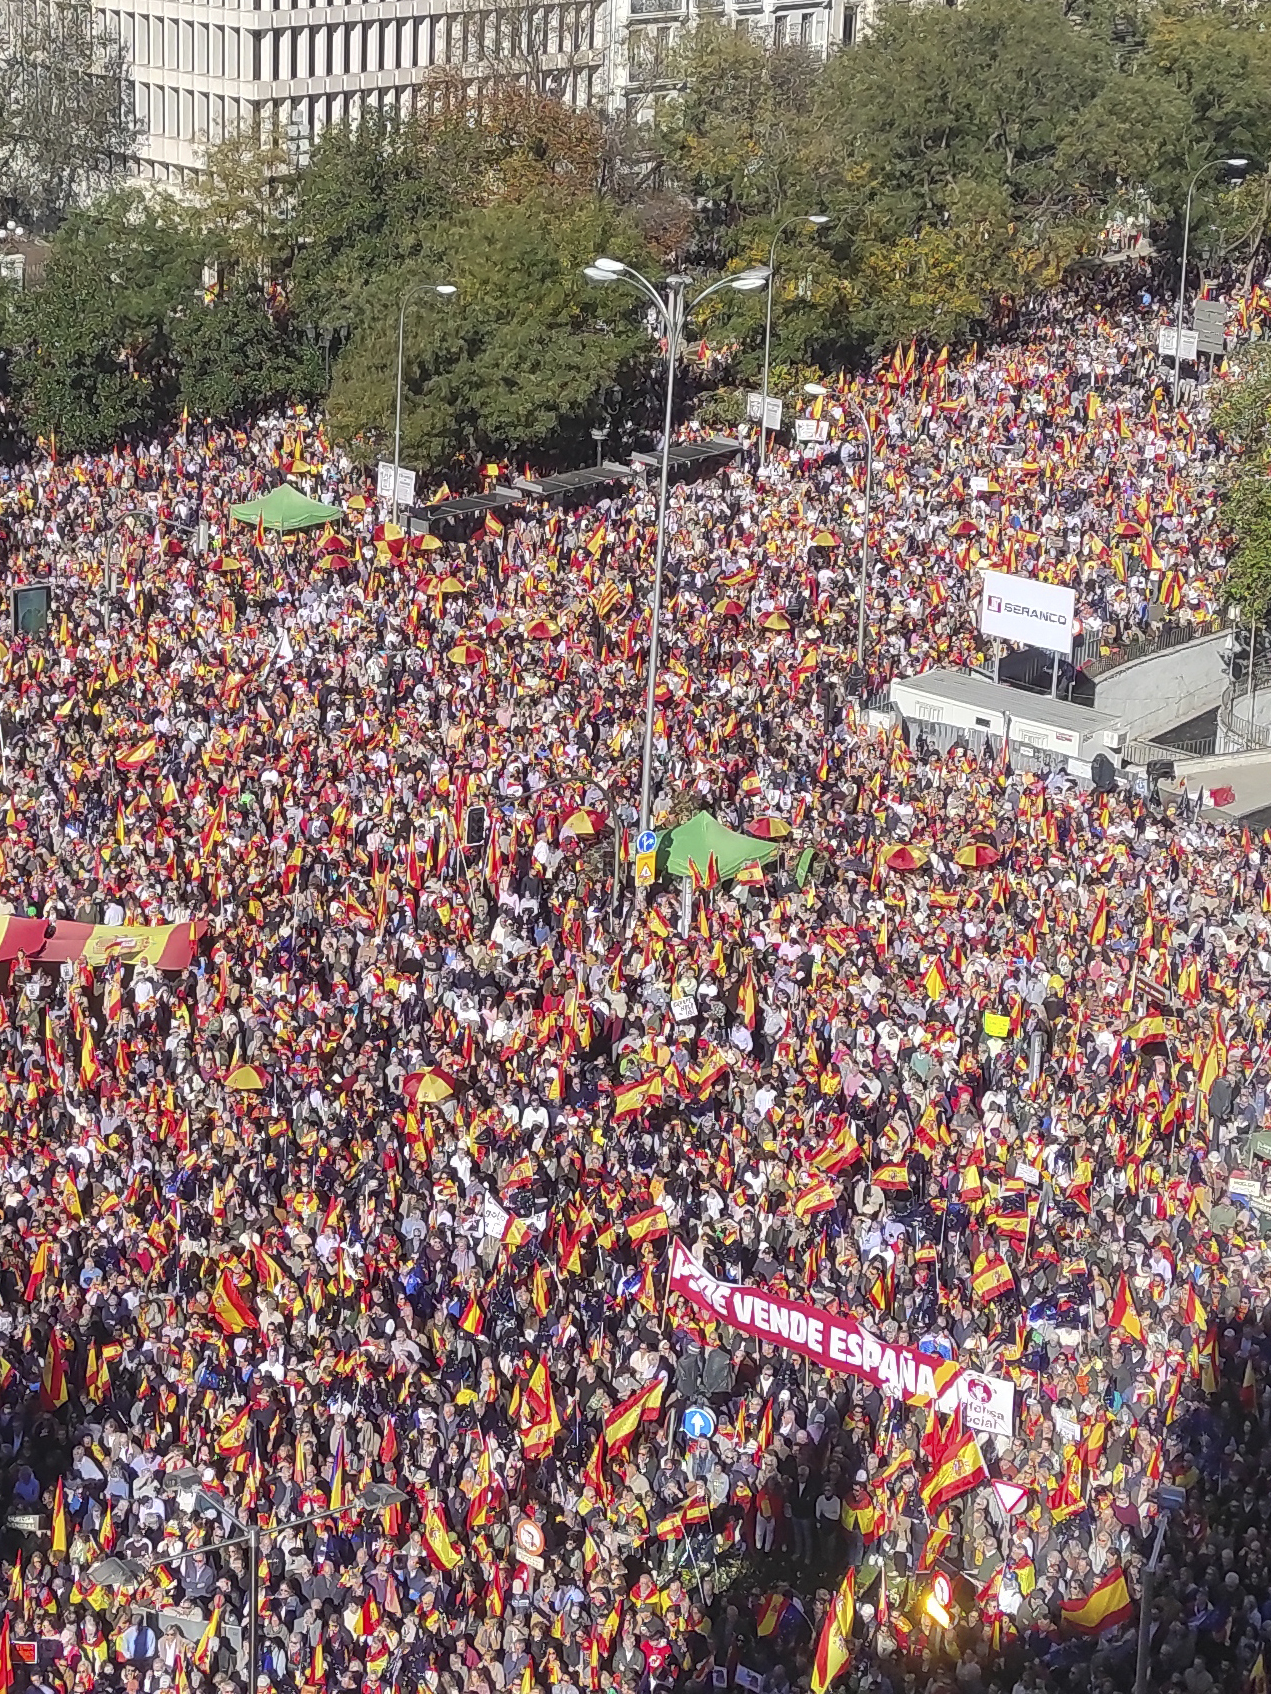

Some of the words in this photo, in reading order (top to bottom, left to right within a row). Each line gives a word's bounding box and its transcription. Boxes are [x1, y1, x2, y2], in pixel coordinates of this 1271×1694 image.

[1004, 602, 1067, 626] SERANCO
[733, 1291, 824, 1355] VENDE
[830, 1326, 938, 1399] ESPAÑA
